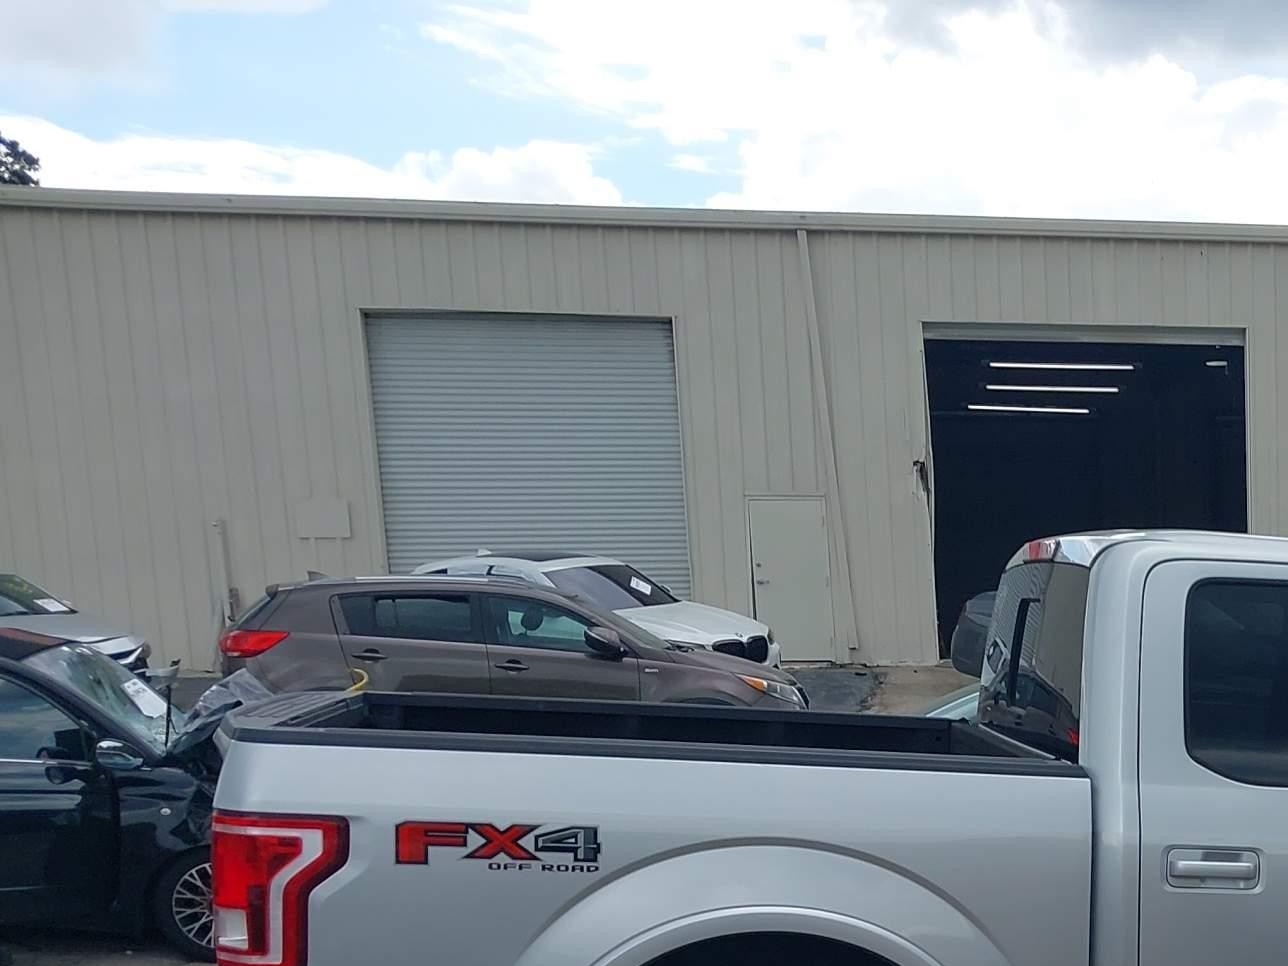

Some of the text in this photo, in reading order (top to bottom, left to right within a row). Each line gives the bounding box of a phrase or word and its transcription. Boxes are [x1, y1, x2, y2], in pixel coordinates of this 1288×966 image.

[395, 820, 601, 865] FX4
[488, 862, 600, 873] OFF ROAD
